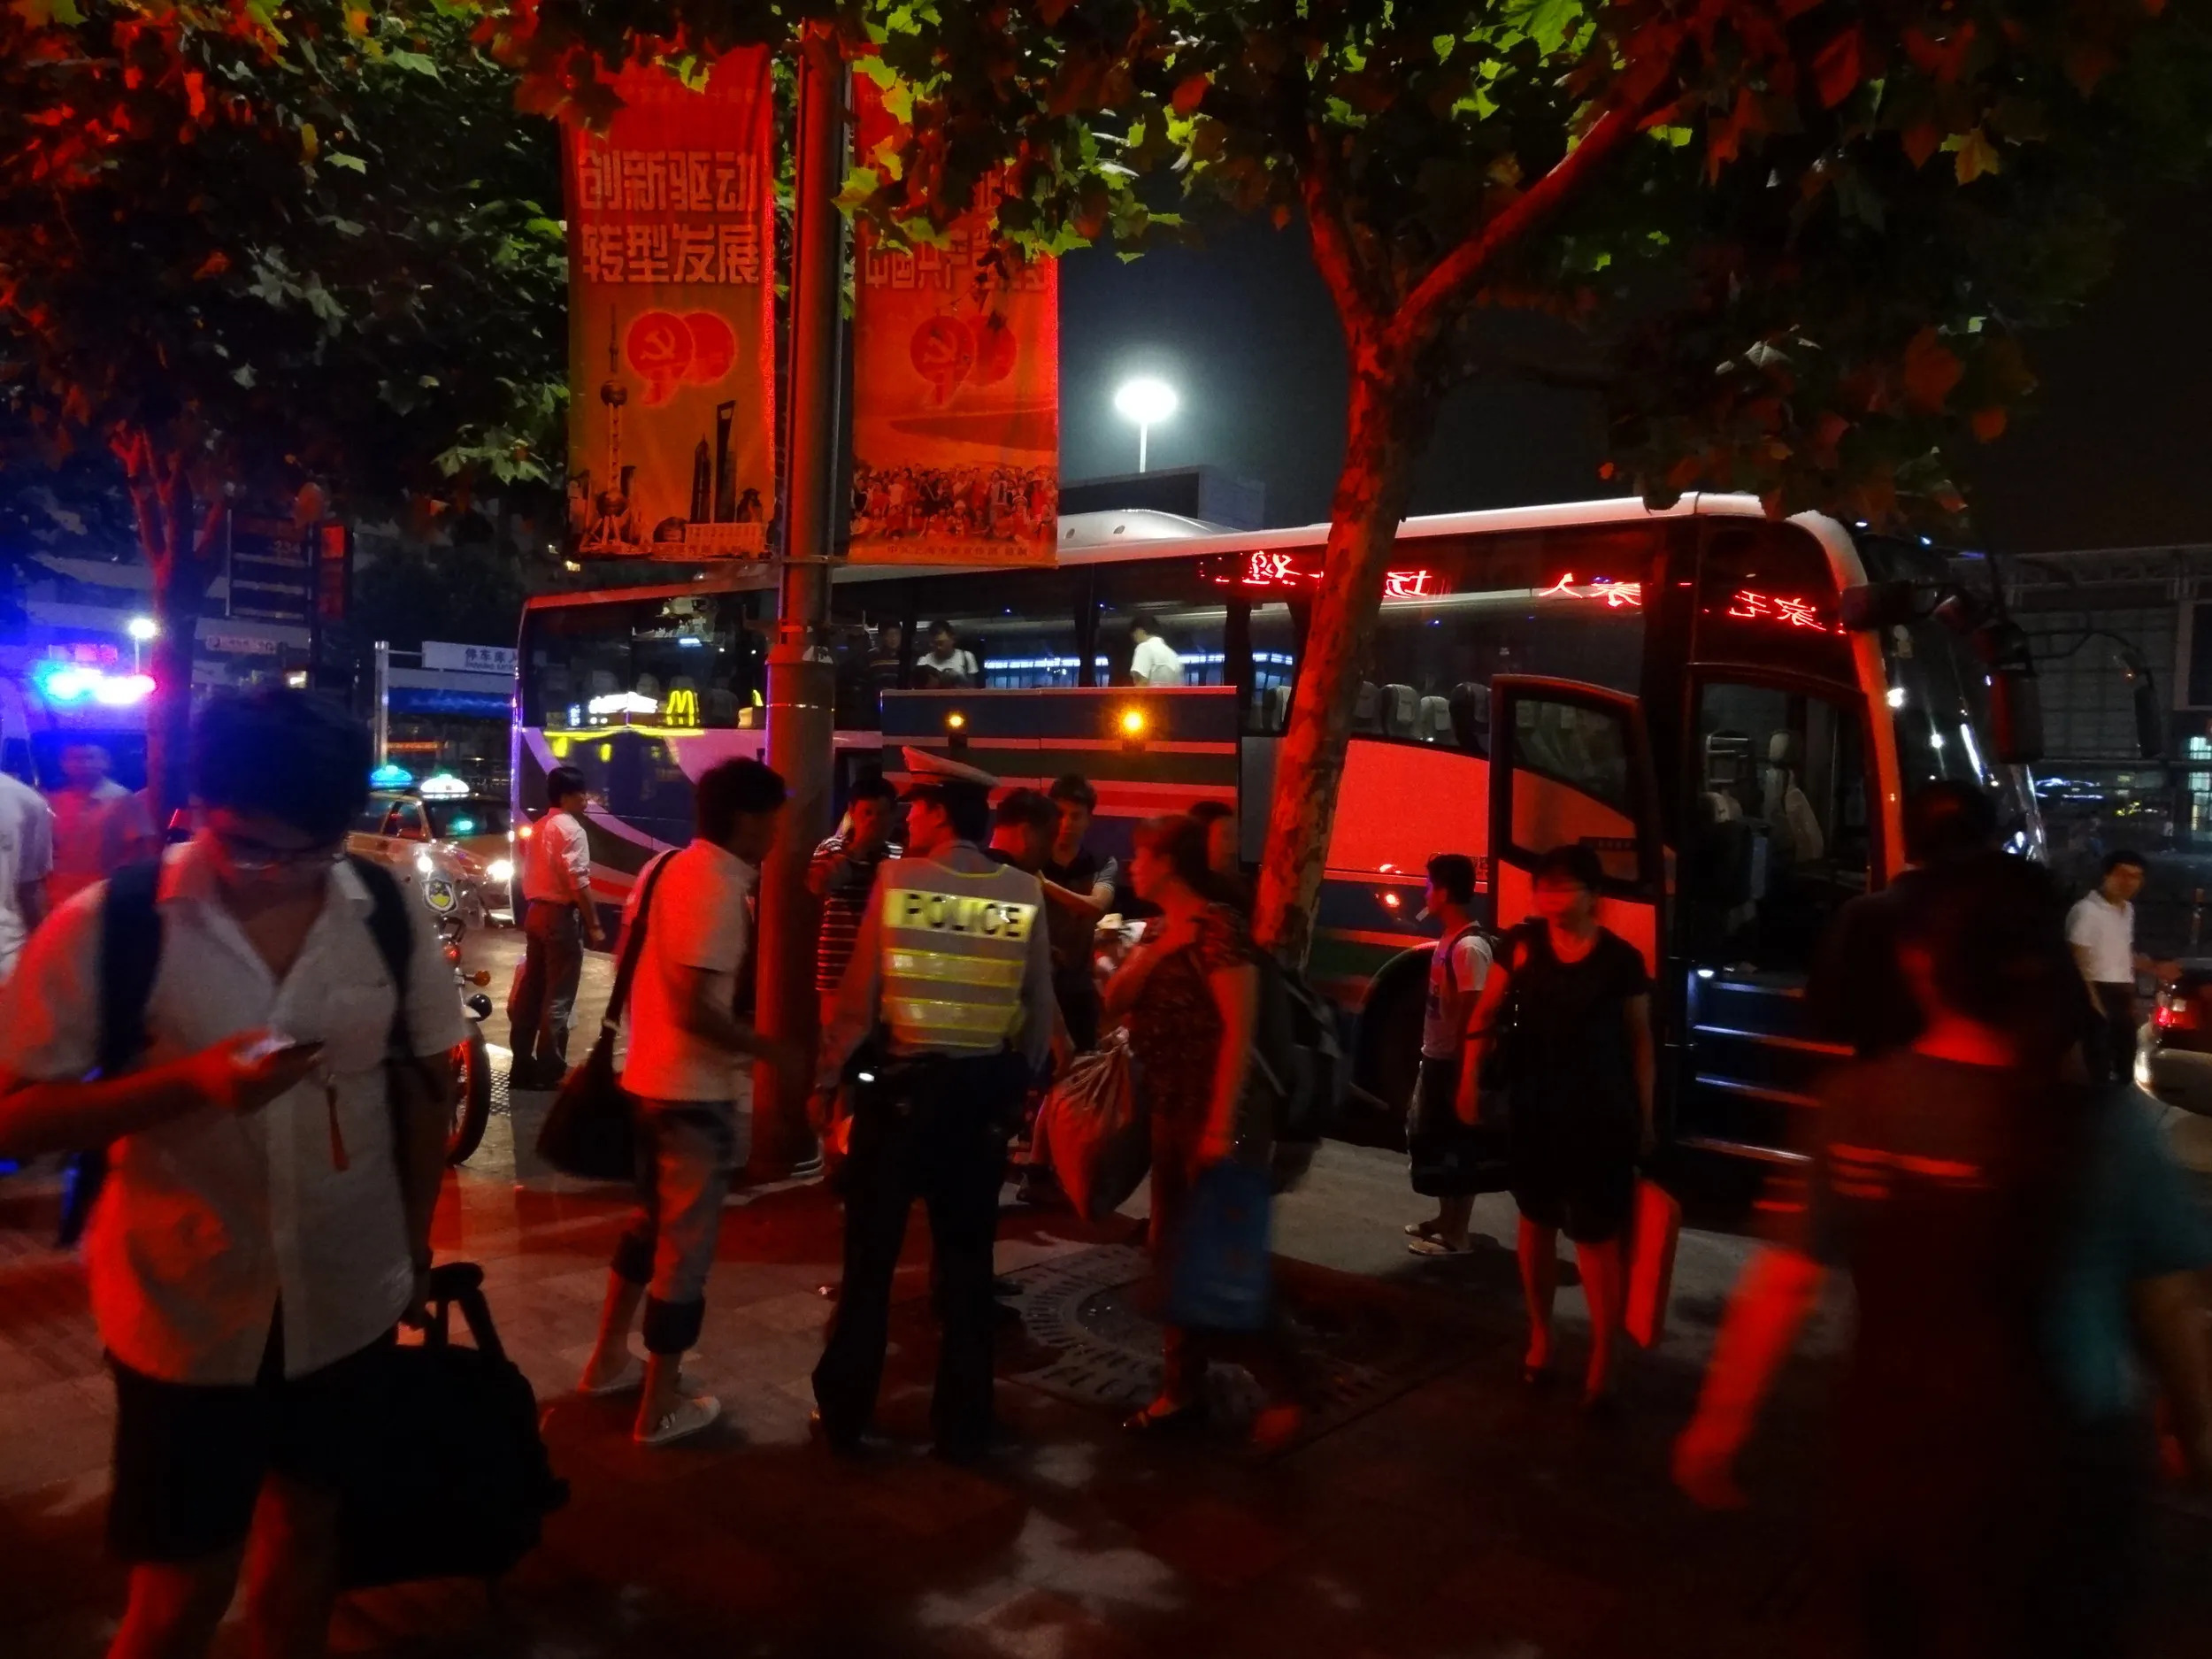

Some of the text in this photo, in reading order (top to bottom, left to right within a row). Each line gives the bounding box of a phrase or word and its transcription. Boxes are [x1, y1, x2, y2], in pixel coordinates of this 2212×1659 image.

[579, 150, 757, 211] 创新驱动
[580, 223, 760, 283] 转型发展
[903, 893, 1021, 937] POLICE
